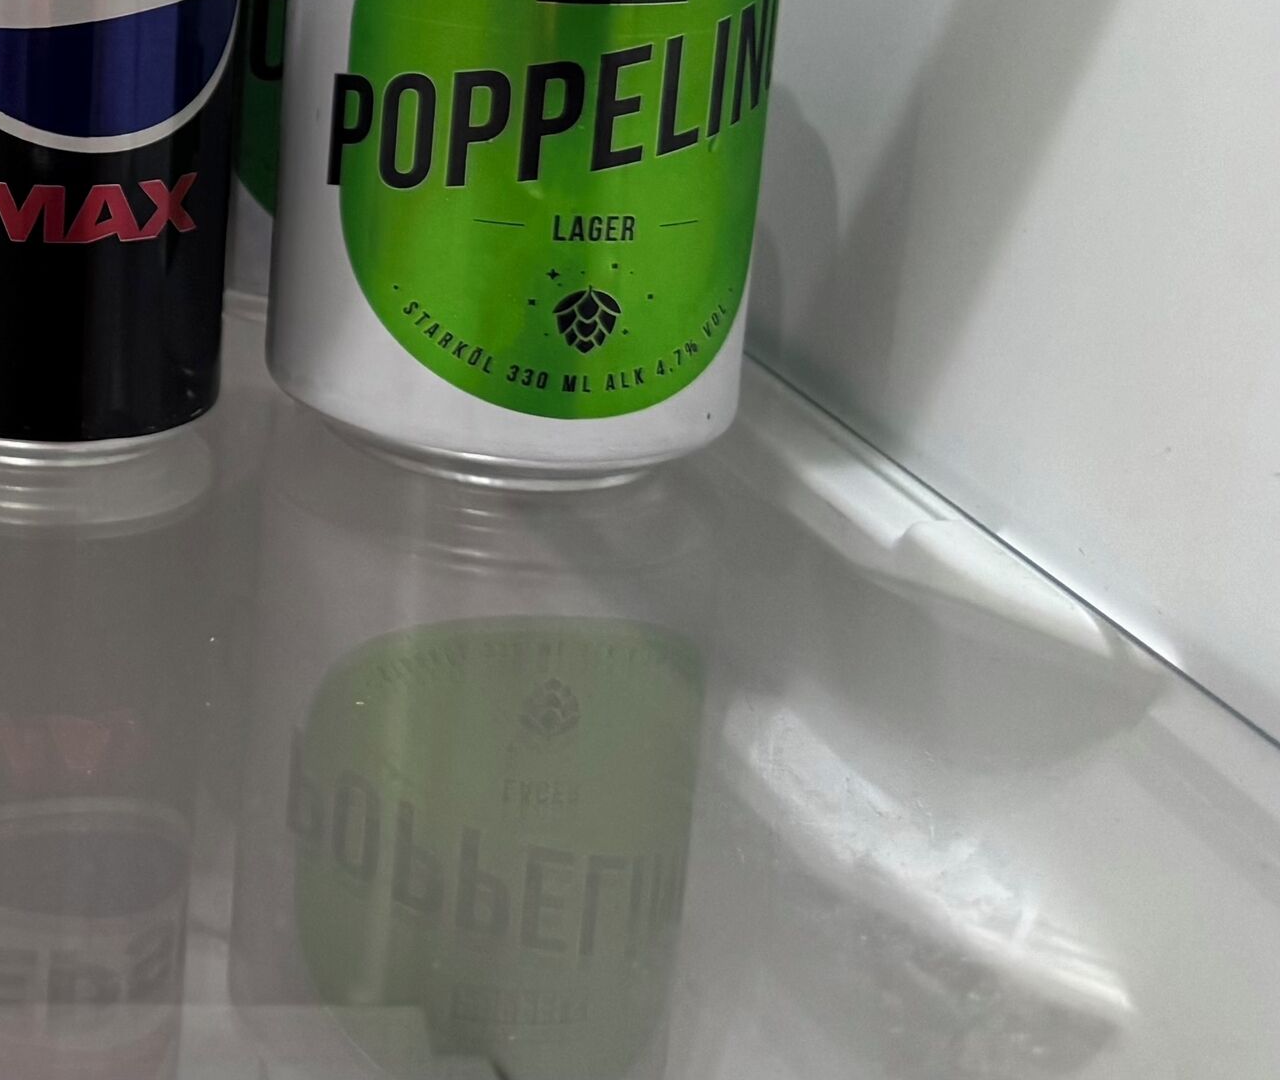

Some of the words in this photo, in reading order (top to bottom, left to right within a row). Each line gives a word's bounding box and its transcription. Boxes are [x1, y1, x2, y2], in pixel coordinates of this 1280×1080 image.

[552, 215, 636, 242] LAGER
[402, 300, 493, 375] STARKÖL
[506, 364, 549, 390] 330
[562, 374, 592, 393] ML
[605, 367, 646, 392] ALK
[654, 338, 700, 376] 4.7%
